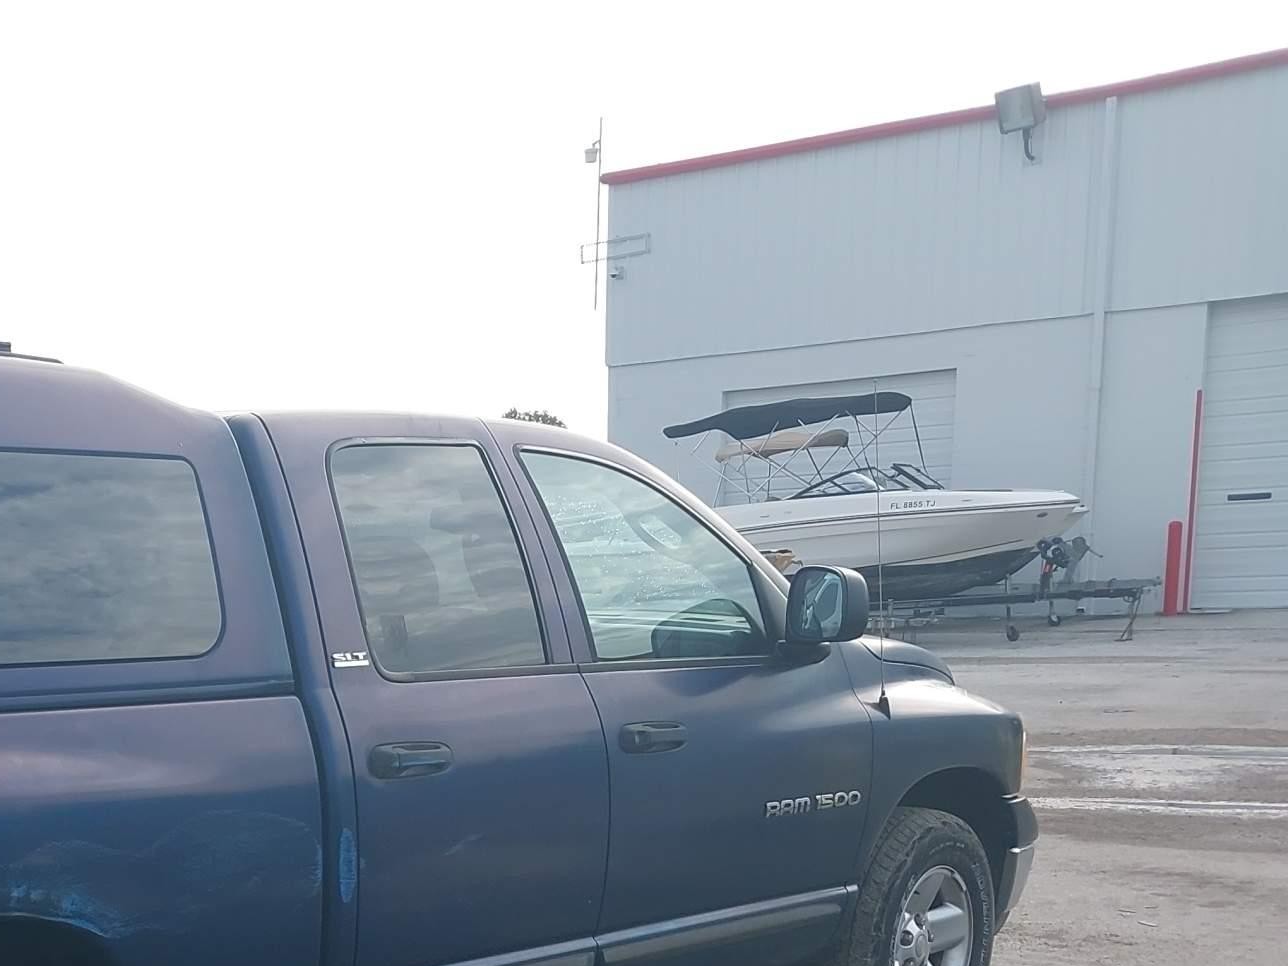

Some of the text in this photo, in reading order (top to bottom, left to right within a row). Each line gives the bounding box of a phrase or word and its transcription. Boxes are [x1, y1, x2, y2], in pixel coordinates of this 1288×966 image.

[890, 502, 901, 510] FL
[332, 652, 367, 661] SLT
[765, 790, 861, 818] RAM 1500
